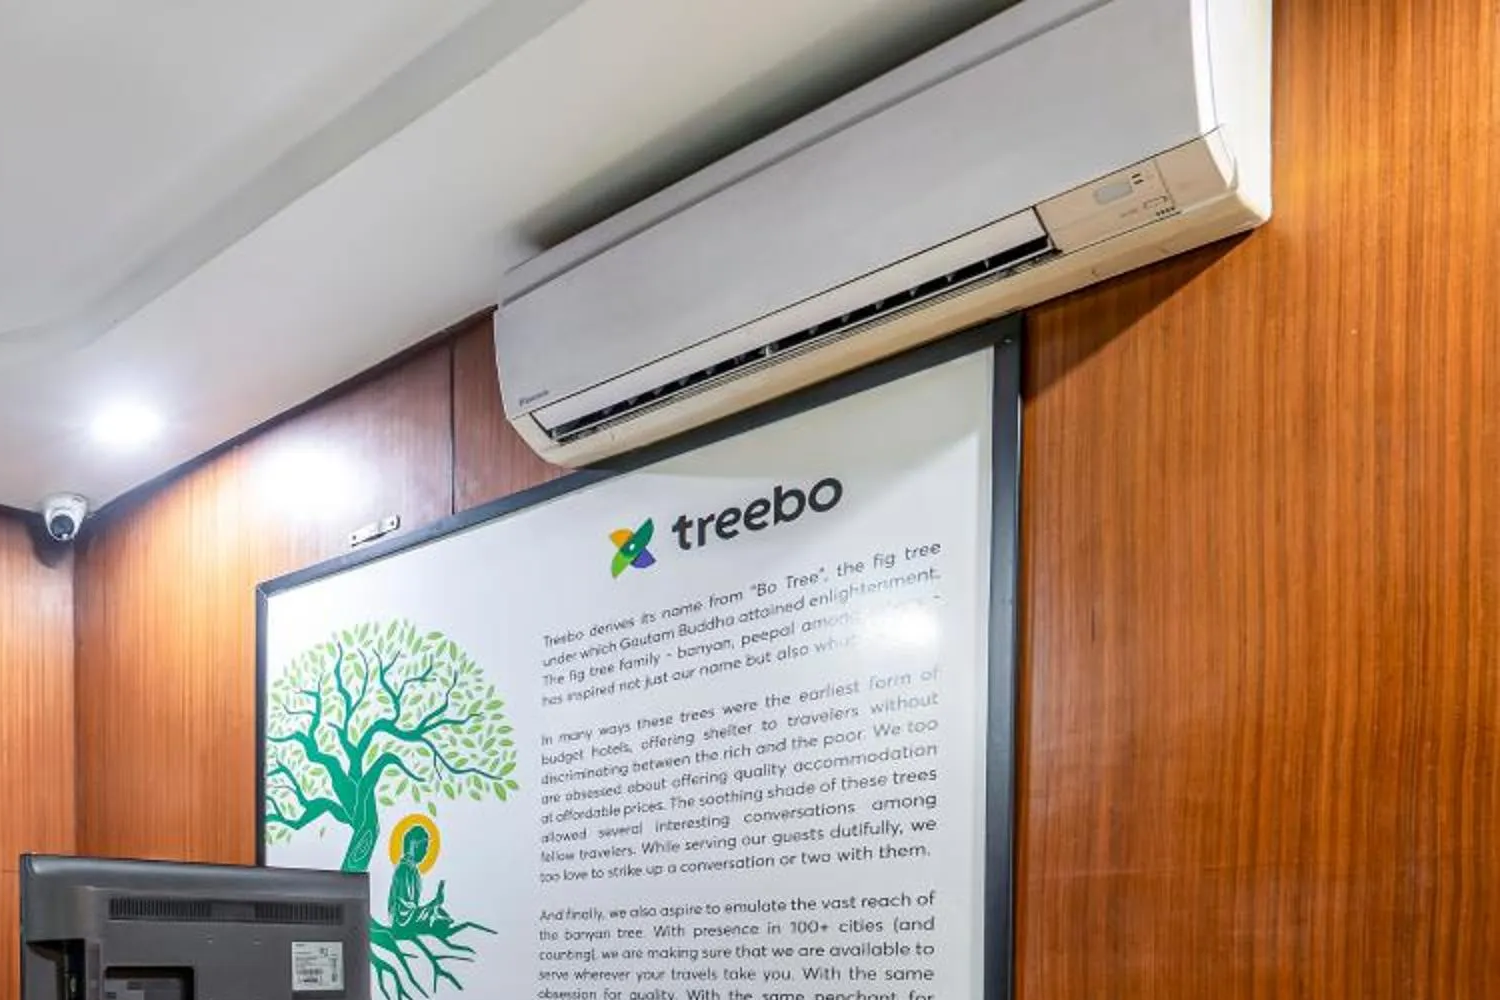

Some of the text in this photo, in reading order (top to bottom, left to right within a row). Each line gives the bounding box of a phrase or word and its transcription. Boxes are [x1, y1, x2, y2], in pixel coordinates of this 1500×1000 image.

[671, 476, 843, 551] treebo
[640, 613, 656, 624] its
[661, 601, 702, 618] name
[709, 591, 742, 607] from
[836, 561, 864, 576] the
[873, 553, 895, 568] fig
[904, 543, 940, 560] tree
[619, 630, 674, 649] Gautam
[678, 616, 734, 636] Buddha
[737, 596, 804, 622] attained
[619, 652, 660, 670] family
[741, 621, 794, 647] peepal
[619, 678, 640, 691] not
[644, 672, 667, 689] just
[671, 668, 695, 680] our
[699, 659, 741, 674] name
[745, 651, 771, 666] but
[776, 645, 809, 660] also
[636, 715, 672, 729] these
[679, 708, 714, 722] trees
[721, 701, 757, 714] were
[764, 693, 790, 707] the
[799, 680, 859, 702] earliest
[869, 673, 911, 688] form
[919, 663, 939, 681] of
[640, 733, 694, 749] offering
[703, 723, 752, 740] shelter
[761, 719, 777, 731] to
[787, 707, 858, 726] travelers
[870, 692, 938, 713] without
[632, 755, 690, 771] between
[695, 749, 718, 763] the
[723, 744, 750, 759] rich
[755, 737, 786, 754] and
[791, 736, 818, 749] the
[873, 723, 900, 736] We
[907, 719, 938, 732] too
[627, 778, 665, 793] about
[671, 771, 727, 787] offering
[733, 763, 786, 781] quality
[793, 745, 937, 772] accommodation
[669, 796, 695, 808] The
[698, 790, 762, 806] soothing
[767, 782, 815, 798] shade
[819, 777, 836, 792] of
[841, 775, 887, 790] these
[892, 769, 937, 784] trees
[655, 815, 729, 831] interesting
[743, 803, 855, 822] conversations
[871, 795, 936, 810] among
[641, 841, 680, 853] While
[684, 837, 736, 850] serving
[741, 835, 765, 844] our
[771, 828, 824, 846] guests
[829, 820, 903, 838] dutifully,
[910, 819, 936, 831] we
[645, 865, 663, 876] up
[667, 863, 676, 873] a
[679, 856, 774, 872] conversation
[779, 855, 796, 865] or
[801, 852, 830, 864] two
[837, 846, 872, 861] with
[629, 905, 656, 917] also
[659, 903, 702, 918] aspire
[705, 903, 720, 914] to
[724, 899, 786, 912] emulate
[790, 897, 816, 910] the
[821, 896, 855, 908] vast
[861, 892, 911, 907] reach
[916, 889, 935, 905] of
[653, 924, 684, 937] With
[693, 925, 759, 938] presence
[767, 921, 781, 934] in
[789, 920, 828, 933] 100+
[838, 919, 883, 932] cities
[621, 949, 643, 958] are
[647, 947, 698, 960] making
[701, 949, 731, 958] sure
[735, 945, 766, 957] that
[771, 947, 794, 956] we
[797, 947, 825, 956] are
[829, 941, 910, 956] available
[915, 943, 934, 955] to
[635, 970, 665, 982] your
[671, 967, 717, 980] travels
[723, 967, 755, 980] take
[802, 966, 840, 979] With
[848, 966, 876, 980] the
[884, 969, 934, 980] same
[686, 989, 720, 1000] With
